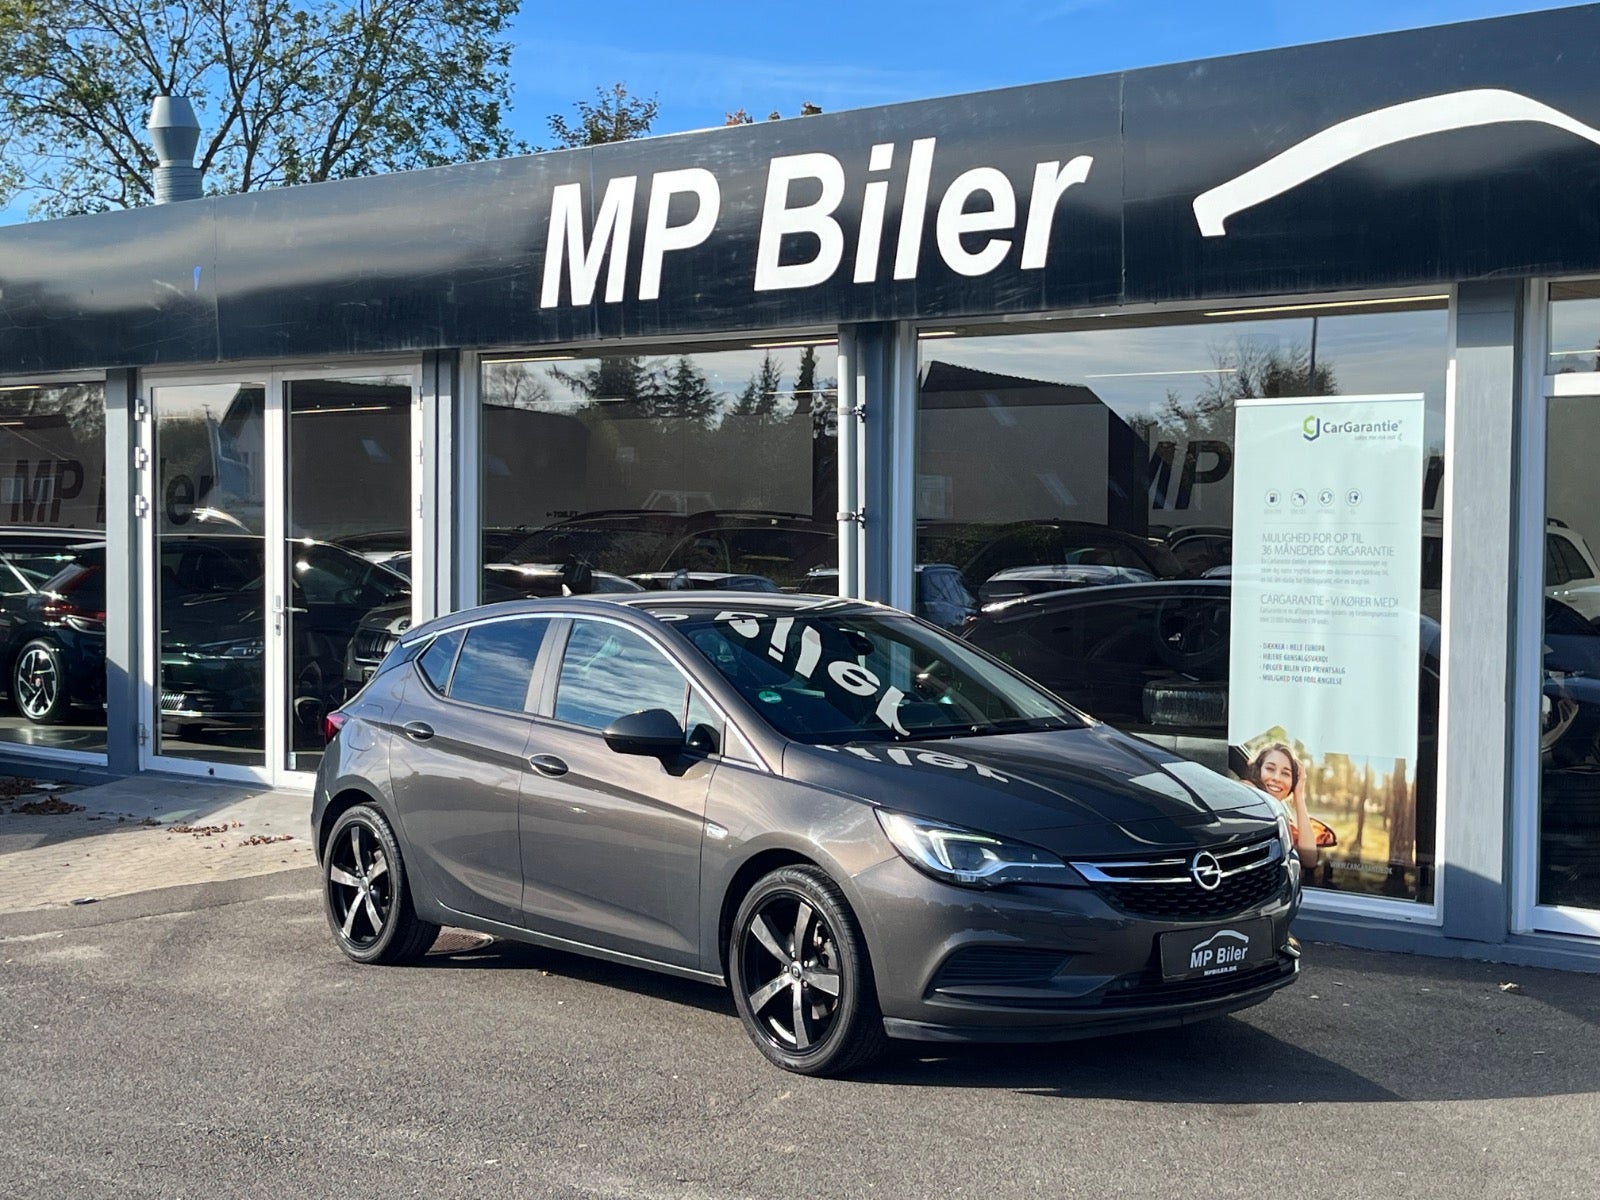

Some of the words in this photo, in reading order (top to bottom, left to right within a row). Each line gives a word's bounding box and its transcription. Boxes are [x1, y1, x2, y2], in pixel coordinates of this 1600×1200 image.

[540, 167, 722, 309] MP
[753, 137, 1094, 292] Biler
[1262, 532, 1311, 544] MULIGHED
[1313, 533, 1332, 544] FOR
[1334, 533, 1349, 544] OP
[1351, 533, 1365, 544] TIL
[1261, 545, 1273, 556] 36
[1274, 543, 1326, 556] MÅNEDERS
[1327, 546, 1395, 557] CARGARANTIE
[1260, 594, 1325, 606] CARGARANTIE
[1190, 949, 1213, 968] MP
[1216, 945, 1248, 964] Biler
